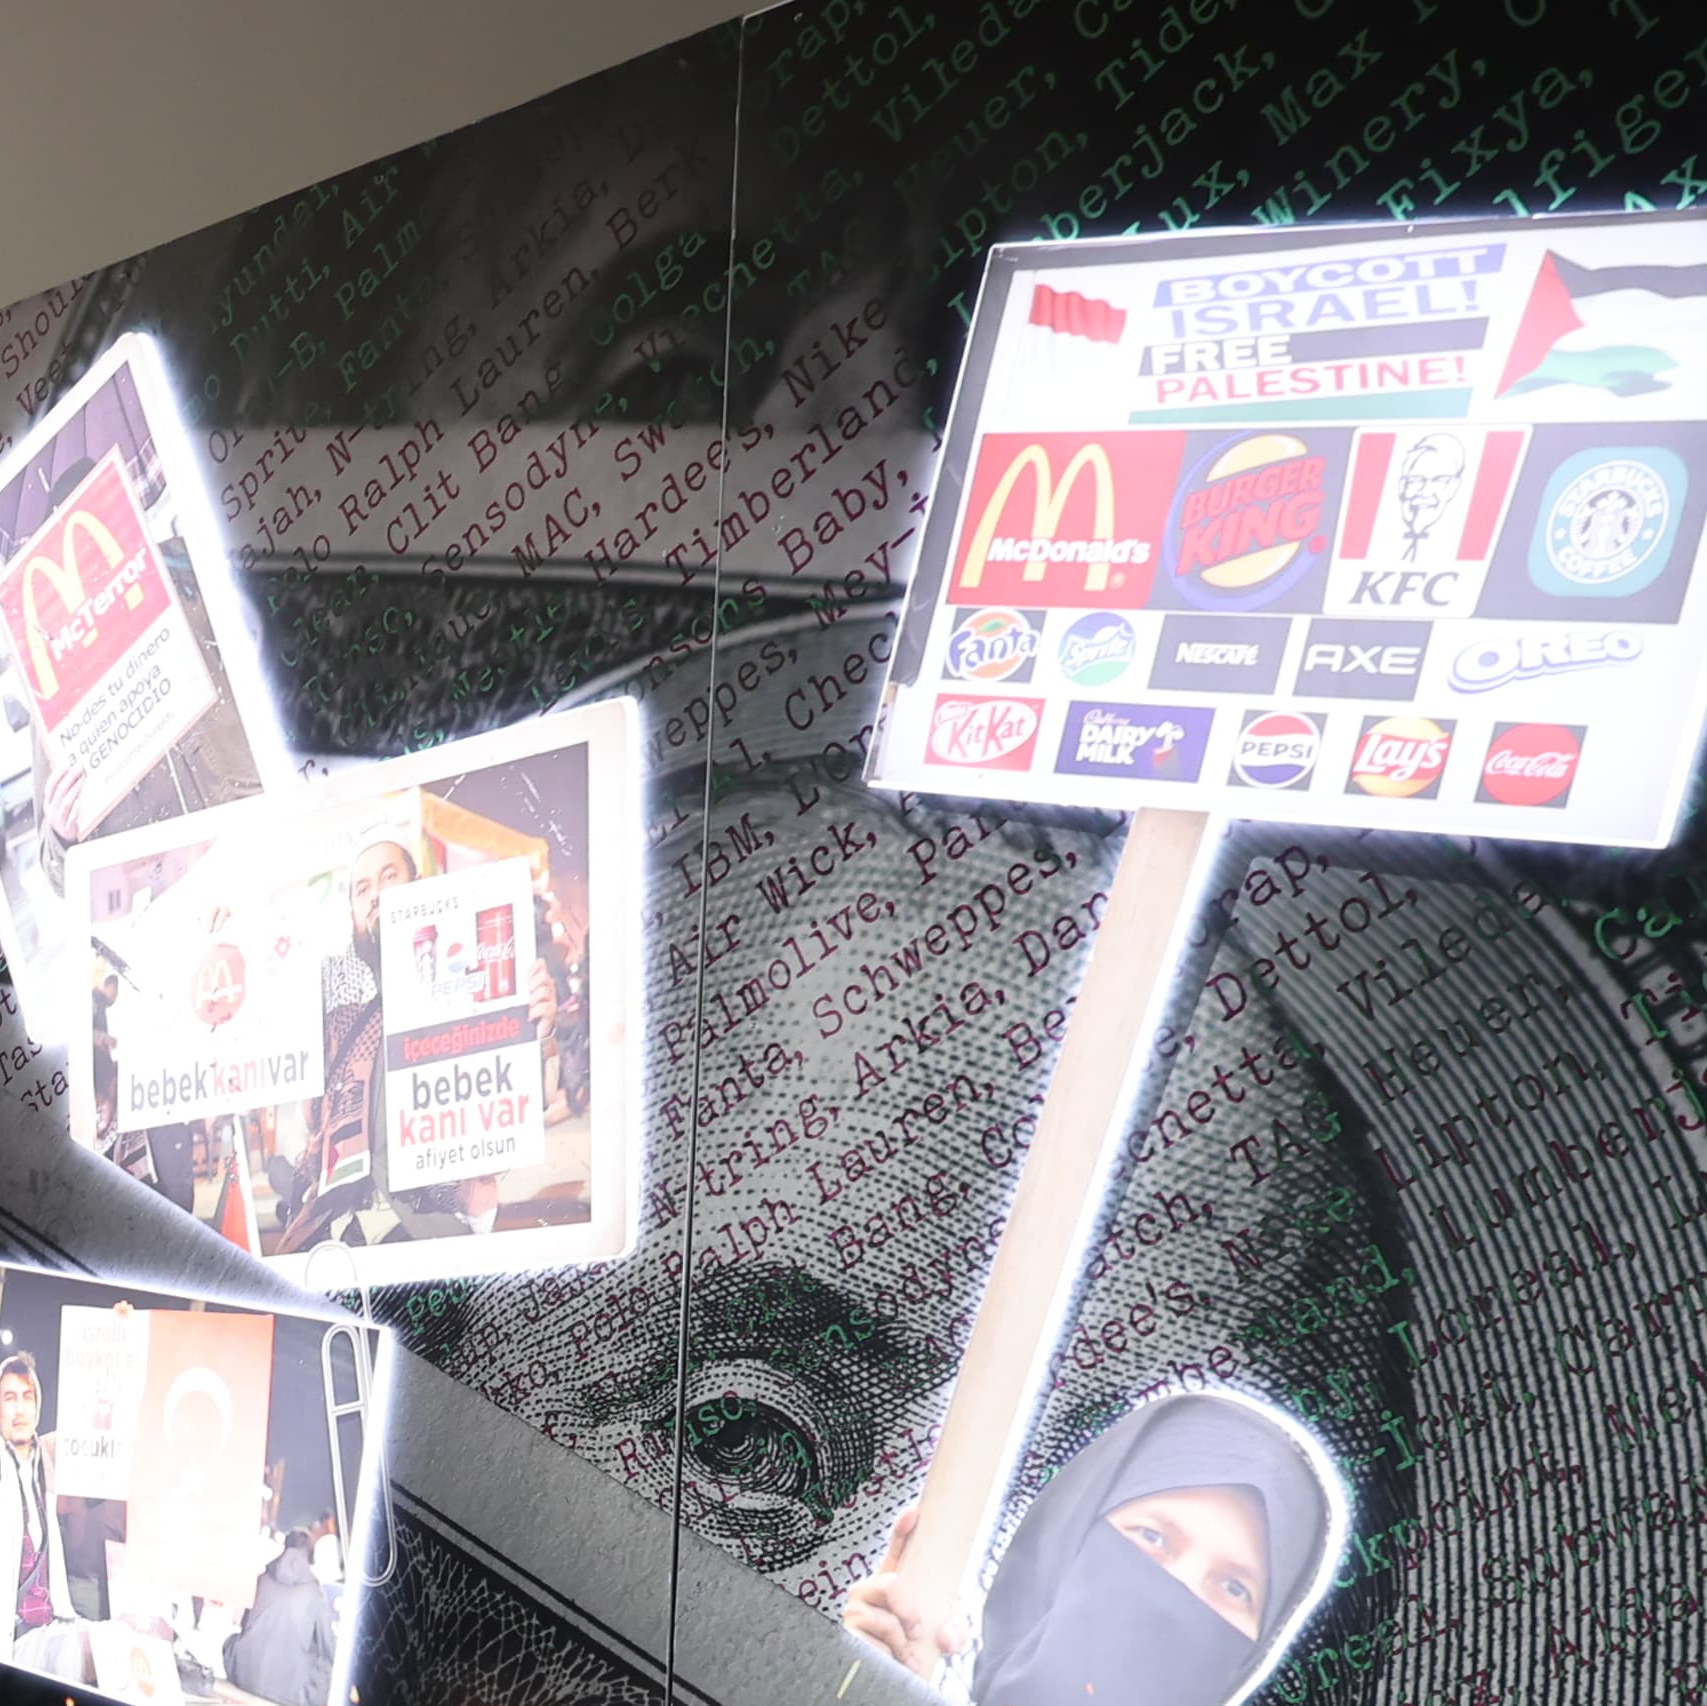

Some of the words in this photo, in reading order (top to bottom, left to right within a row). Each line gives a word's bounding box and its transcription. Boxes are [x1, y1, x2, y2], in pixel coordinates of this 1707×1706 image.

[1260, 26, 1384, 147] Max
[1163, 248, 1492, 304] BOYCOTT
[1171, 284, 1483, 338] ISRAEL!
[784, 296, 891, 411] Nike
[1149, 334, 1293, 375] FREE
[1155, 356, 1469, 404] PALESTINE!
[338, 417, 446, 537] Ralph
[449, 264, 601, 418] Lauren,
[386, 467, 463, 556] Clit
[777, 457, 910, 577] Baby,
[1183, 455, 1326, 530] BURGER
[1557, 460, 1665, 518] STARBUCKS
[510, 486, 603, 582] MAC,
[987, 538, 1151, 565] McDonald's
[50, 544, 149, 662] McTerror
[1348, 569, 1460, 608] KFC
[107, 675, 126, 699] tu
[124, 625, 171, 683] dinero
[947, 629, 1041, 680] Fanta
[1304, 643, 1422, 676] AXE
[1453, 632, 1643, 690] OREO
[76, 707, 120, 757] quien
[118, 661, 163, 718] apoya
[88, 676, 173, 771] GENOCIDIO
[1081, 723, 1157, 748] DAIRY
[1076, 743, 1134, 766] MILK
[1241, 740, 1313, 760] PEPSI
[1352, 732, 1448, 781] Lay's
[671, 812, 776, 899] IBM,
[756, 821, 879, 916] Wick,
[389, 895, 461, 925] STARBUCKS
[1206, 866, 1421, 1023] Dettol,
[431, 971, 490, 1001] PEPSI
[657, 890, 896, 1067] Palmolive,
[658, 1039, 805, 1143] Fanta,
[810, 836, 1080, 1041] Schweppes,
[401, 1015, 523, 1062] içeceğinizde
[850, 980, 1007, 1099] Arkia,
[129, 1060, 209, 1113] bebek
[267, 1048, 310, 1087] var
[411, 1055, 514, 1112] bebek
[398, 1107, 468, 1149] kanı
[477, 1092, 531, 1134] var
[804, 1073, 996, 1207] Lauren,
[415, 1142, 466, 1171] afiyet
[469, 1135, 518, 1159] olsun
[827, 1169, 972, 1272] Bang,
